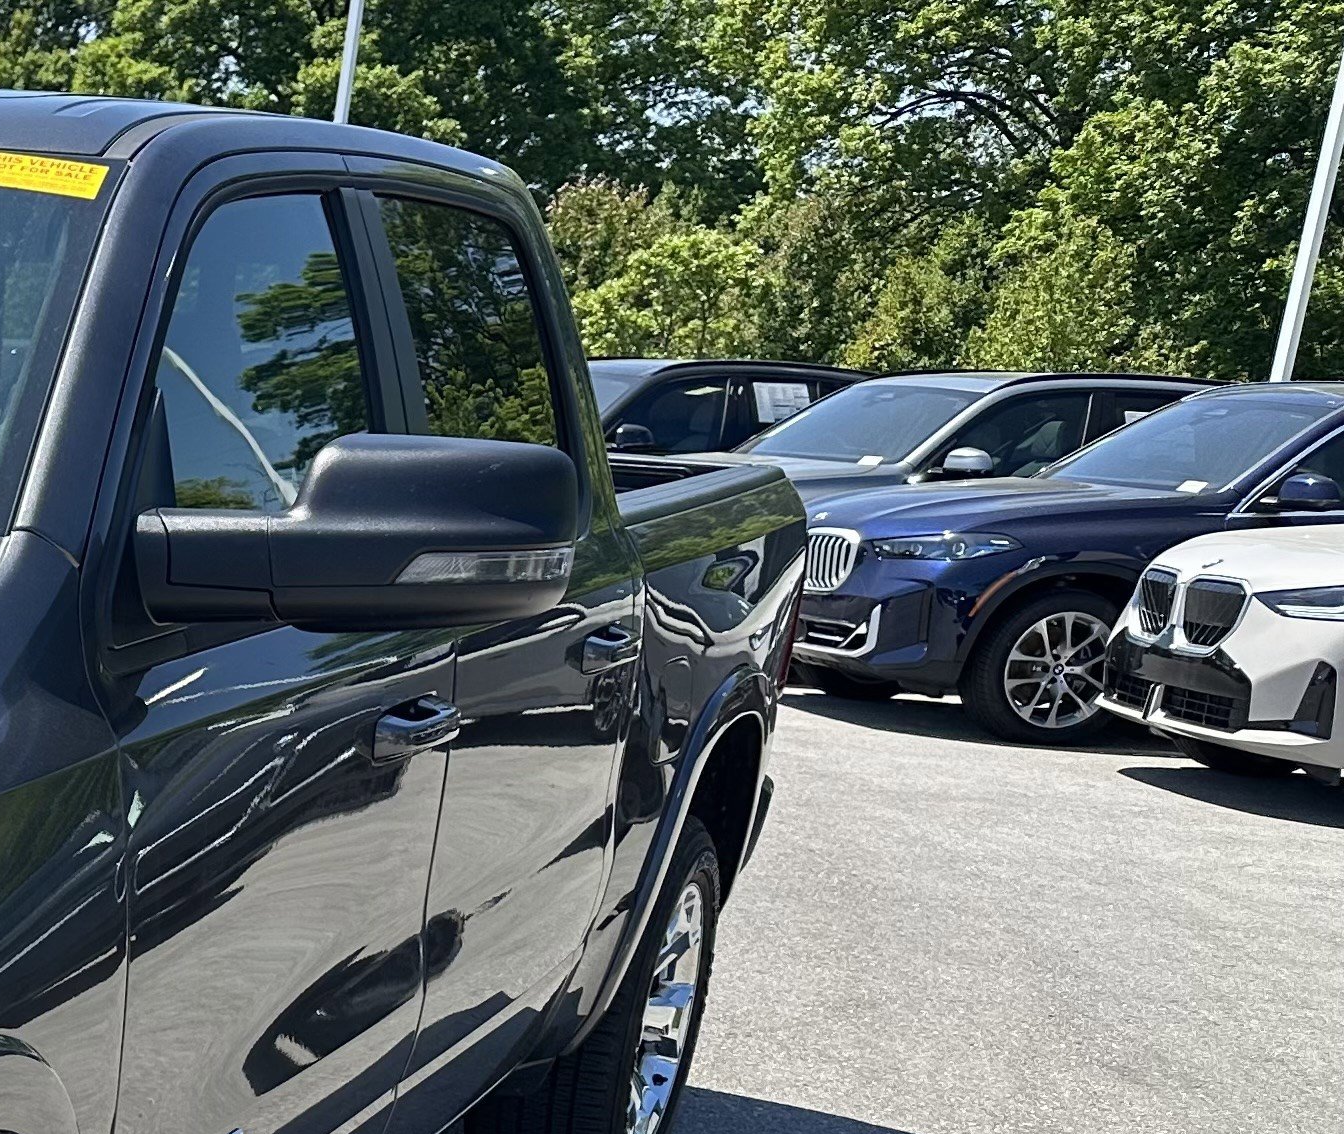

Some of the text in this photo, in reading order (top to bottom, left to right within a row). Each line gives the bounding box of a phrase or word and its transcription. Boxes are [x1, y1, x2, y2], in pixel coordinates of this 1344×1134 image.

[20, 166, 50, 175] FOR
[54, 171, 93, 181] SALE
[29, 158, 99, 174] VEHICLE
